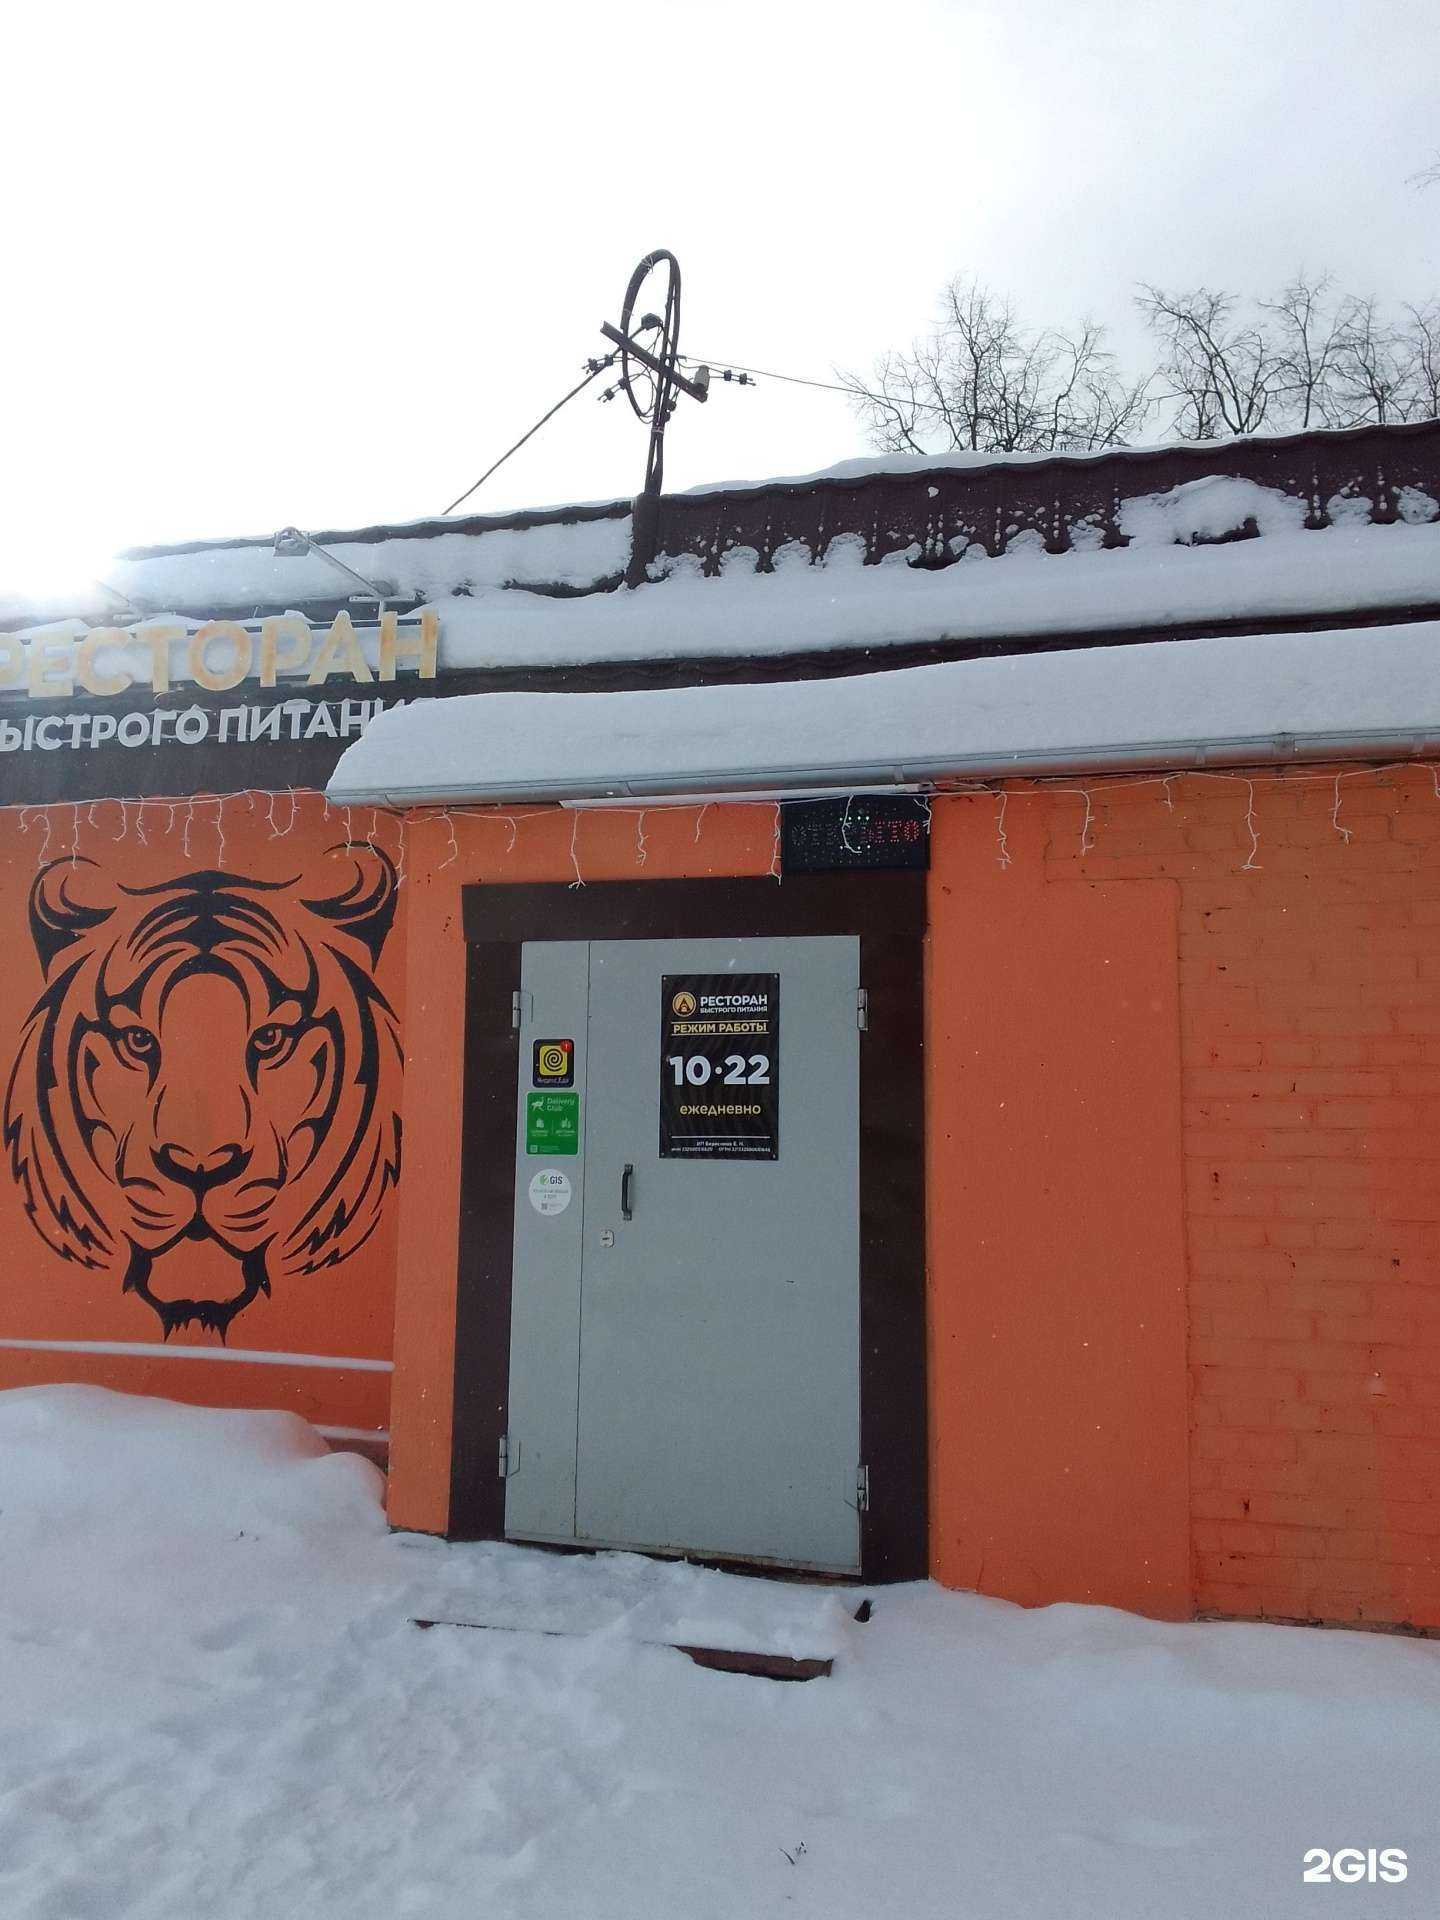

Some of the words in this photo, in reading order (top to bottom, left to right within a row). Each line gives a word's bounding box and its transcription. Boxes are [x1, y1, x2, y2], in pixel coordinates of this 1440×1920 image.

[218, 698, 405, 743] ПИТАН
[700, 995, 768, 1007] РЕСТОРАН
[700, 1006, 736, 1014] БЫСТРОГО
[736, 1005, 768, 1013] ПИТАНИЯ
[673, 1023, 716, 1034] РЕЖИМ
[719, 1022, 767, 1033] РАБОТЫ
[680, 1105, 761, 1116] ежедневно
